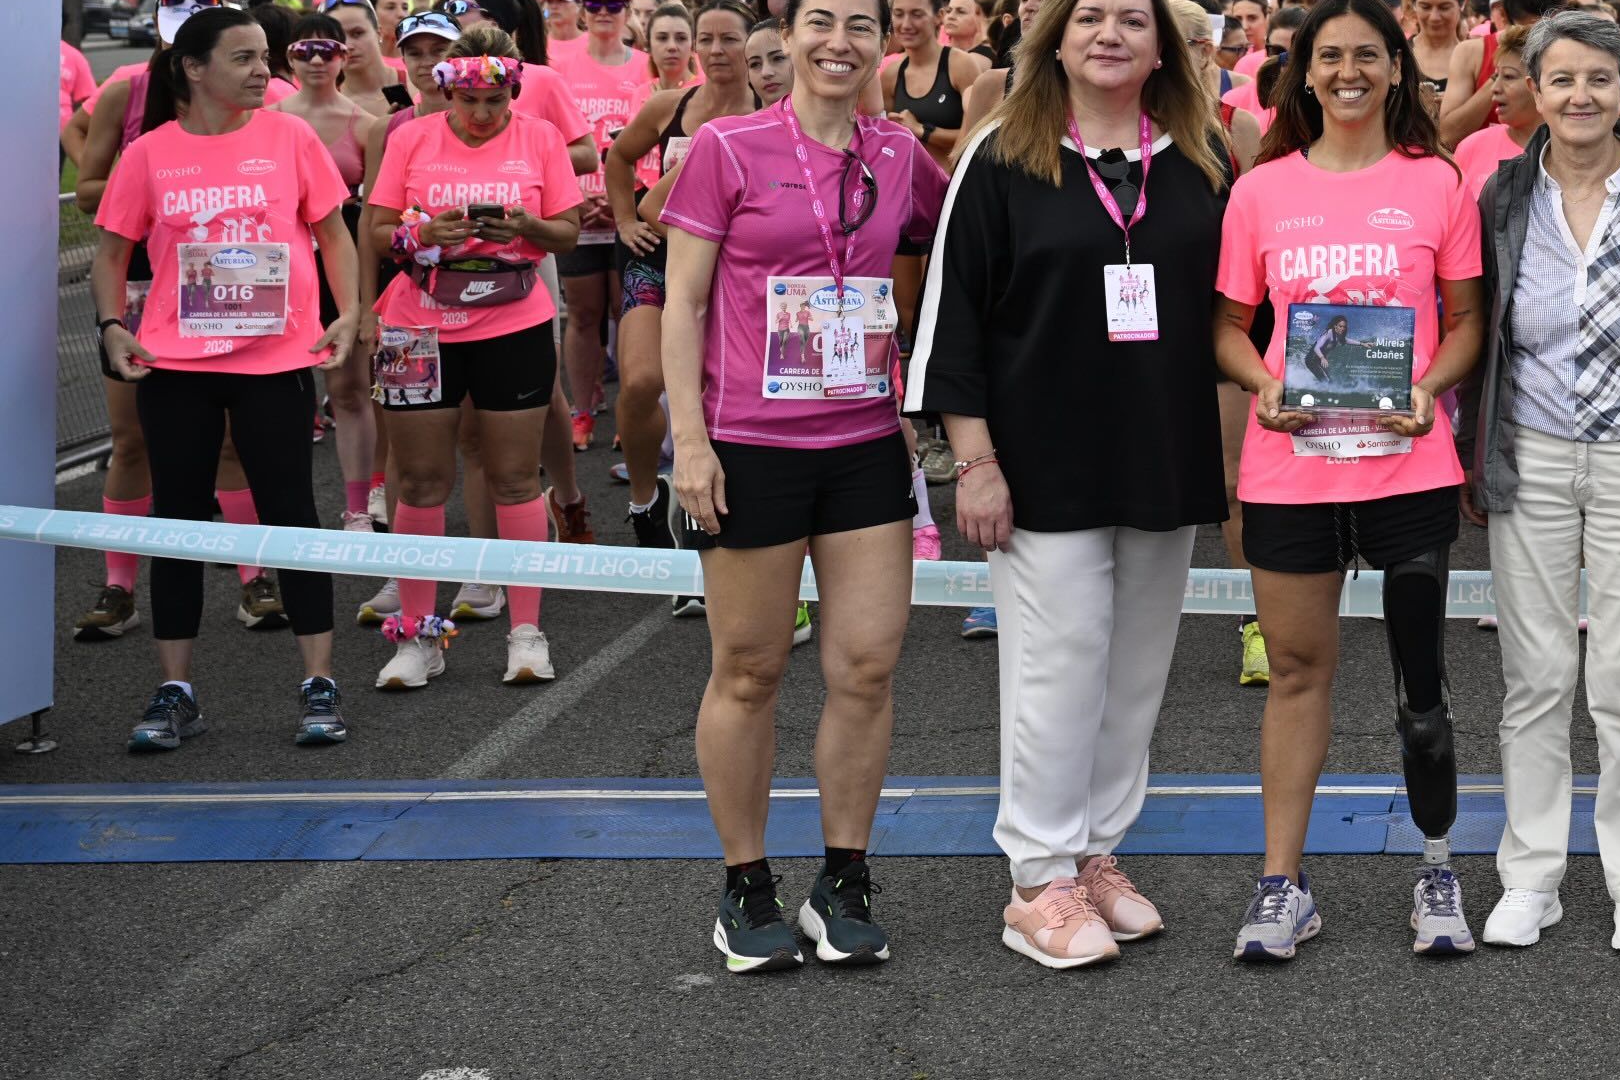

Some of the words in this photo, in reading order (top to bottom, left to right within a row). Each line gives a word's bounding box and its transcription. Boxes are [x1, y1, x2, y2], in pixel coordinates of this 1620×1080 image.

[156, 165, 202, 180] OYSHO
[163, 183, 269, 216] CARRERA
[427, 182, 522, 208] CARRERA
[1275, 215, 1324, 233] OYSHO
[1371, 215, 1411, 226] ASTURIANA
[213, 256, 254, 265] ASTURIANA
[1280, 243, 1401, 282] CARRERA
[213, 285, 254, 301] 016
[468, 280, 496, 294] NIKE
[786, 288, 807, 296] UMA
[813, 294, 861, 306] ASTUIANA
[441, 311, 468, 325] 2026
[189, 322, 223, 330] OYSHO
[1113, 332, 1155, 340] PATROCINADOR
[203, 339, 234, 354] 2026
[1376, 337, 1405, 348] Mireia
[1366, 349, 1405, 360] Cabañes
[780, 367, 809, 375] CARRERA
[811, 367, 819, 375] DE
[779, 381, 823, 392] OYSHO
[827, 386, 863, 396] PATROCINADOR
[1300, 428, 1327, 436] CARRERA
[1338, 426, 1347, 434] LA
[1348, 425, 1370, 433] MUJER
[1367, 439, 1402, 449] Santander
[89, 526, 238, 552] SPORTLIFE
[311, 541, 456, 567] SPORTLIFE
[528, 552, 673, 580] SPORTLIFE
